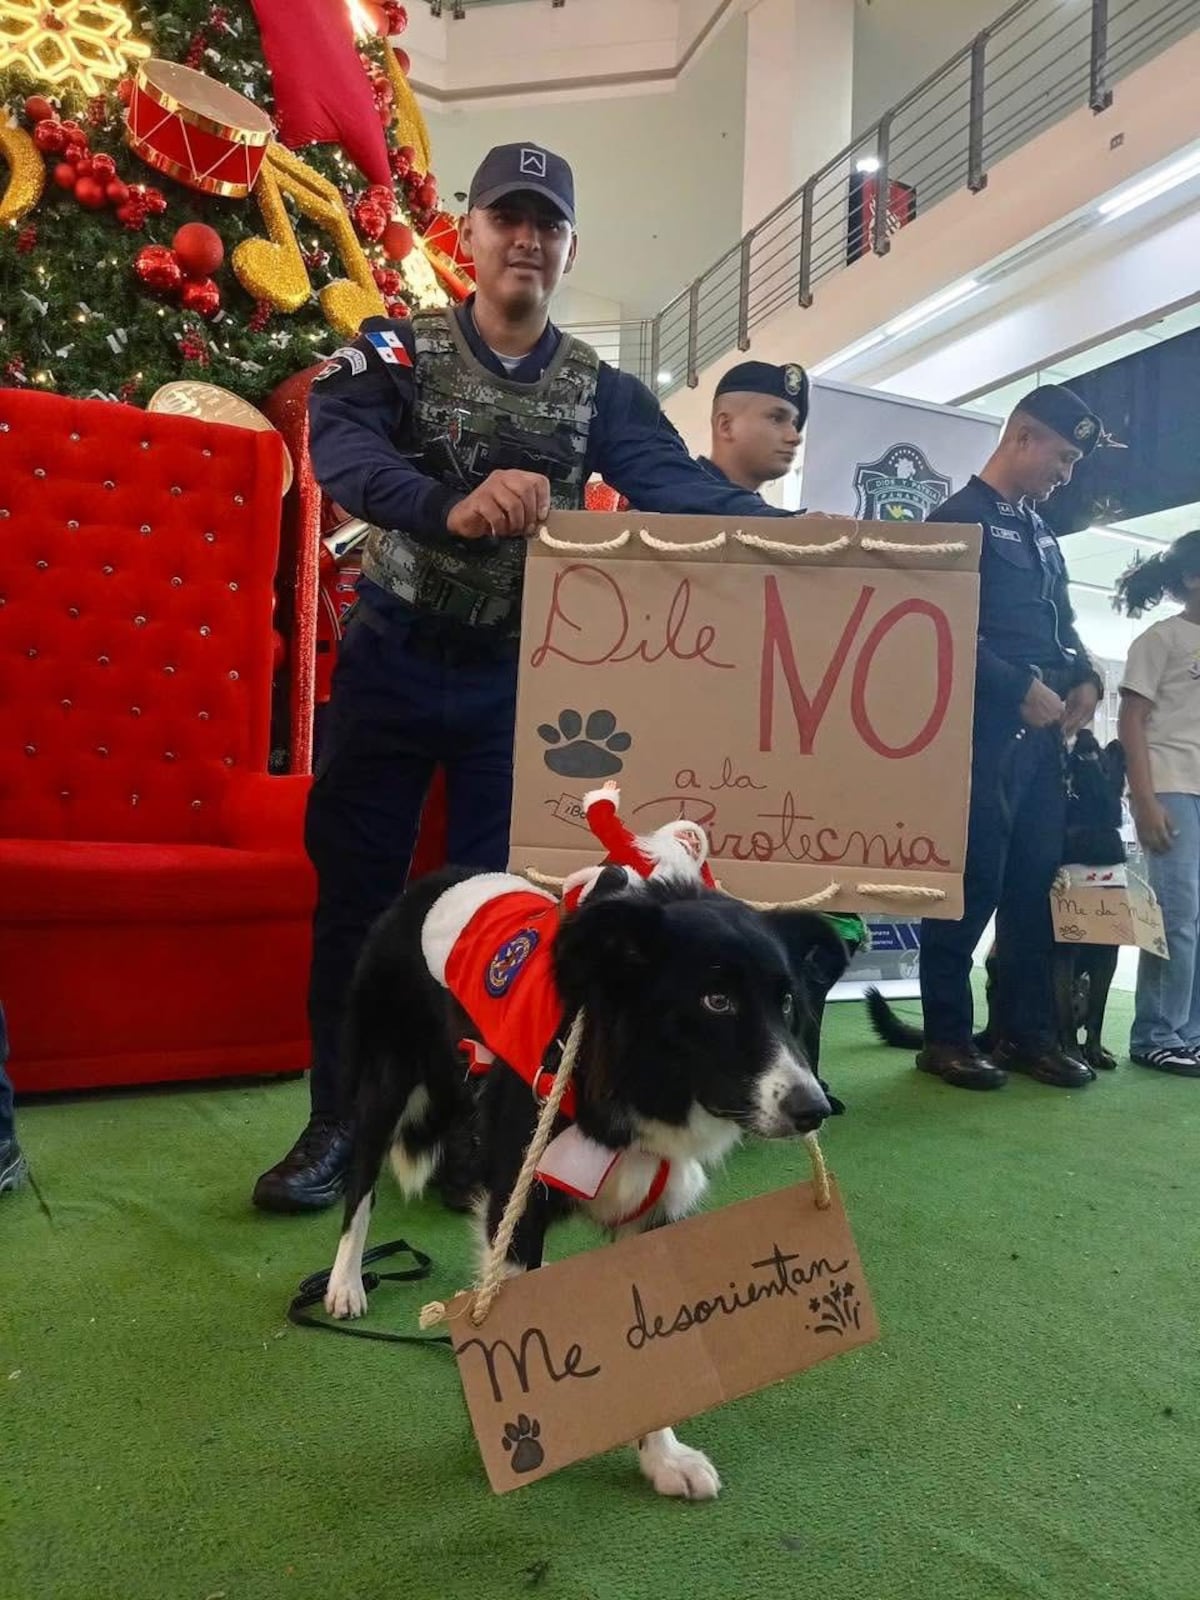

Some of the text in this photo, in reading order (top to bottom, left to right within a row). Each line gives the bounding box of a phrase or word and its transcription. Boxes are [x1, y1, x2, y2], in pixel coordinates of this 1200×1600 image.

[911, 481, 938, 500] PATRIA
[531, 563, 954, 760] Dile NO
[674, 757, 768, 790] a la
[632, 790, 950, 867] Pirotecnia
[1054, 895, 1088, 916] Me
[1095, 899, 1118, 917] da
[456, 1243, 850, 1403] Me desorientan
